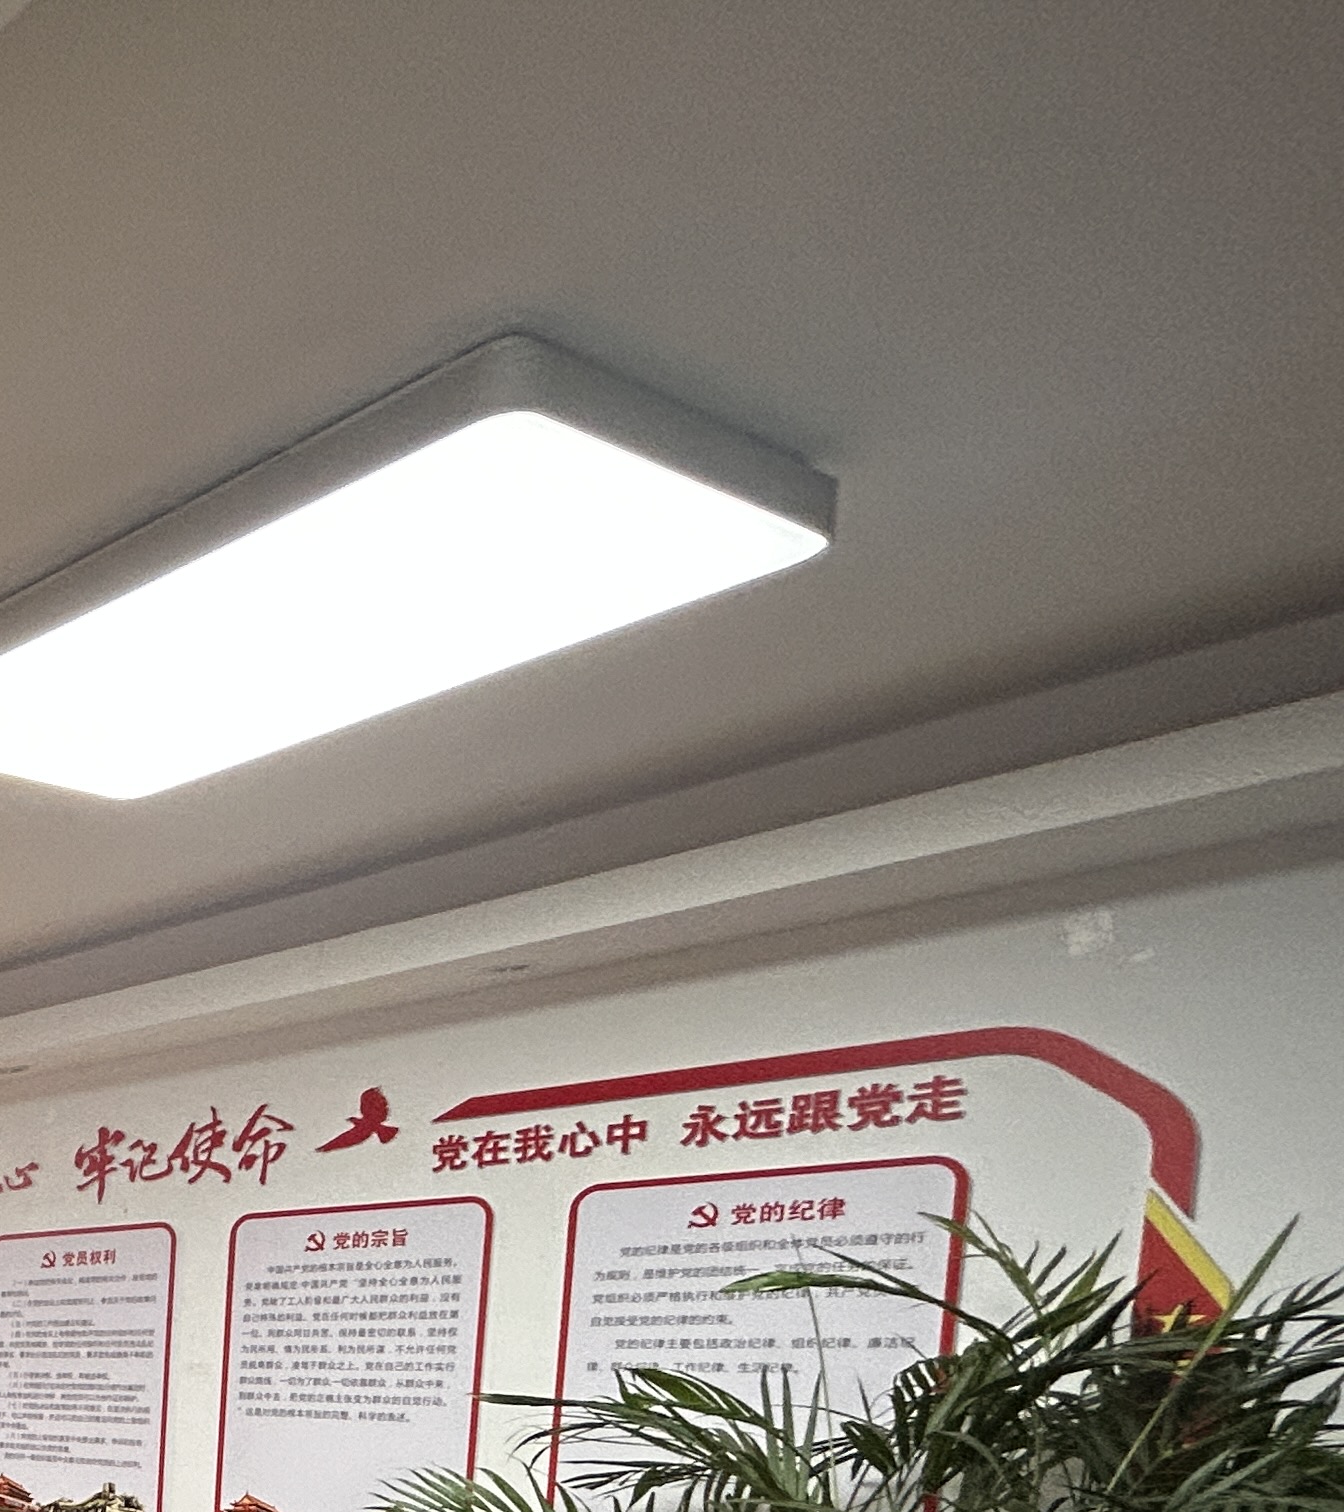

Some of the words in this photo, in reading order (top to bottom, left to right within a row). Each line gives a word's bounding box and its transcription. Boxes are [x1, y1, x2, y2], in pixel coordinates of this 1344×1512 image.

[431, 1114, 648, 1173] 党在我心中
[680, 1074, 969, 1148] 永远跟党走
[75, 1104, 294, 1204] 牢记使命
[730, 1197, 847, 1226] 党的纪律
[332, 1228, 409, 1250] 党的宗旨
[62, 1249, 117, 1267] 党员权利
